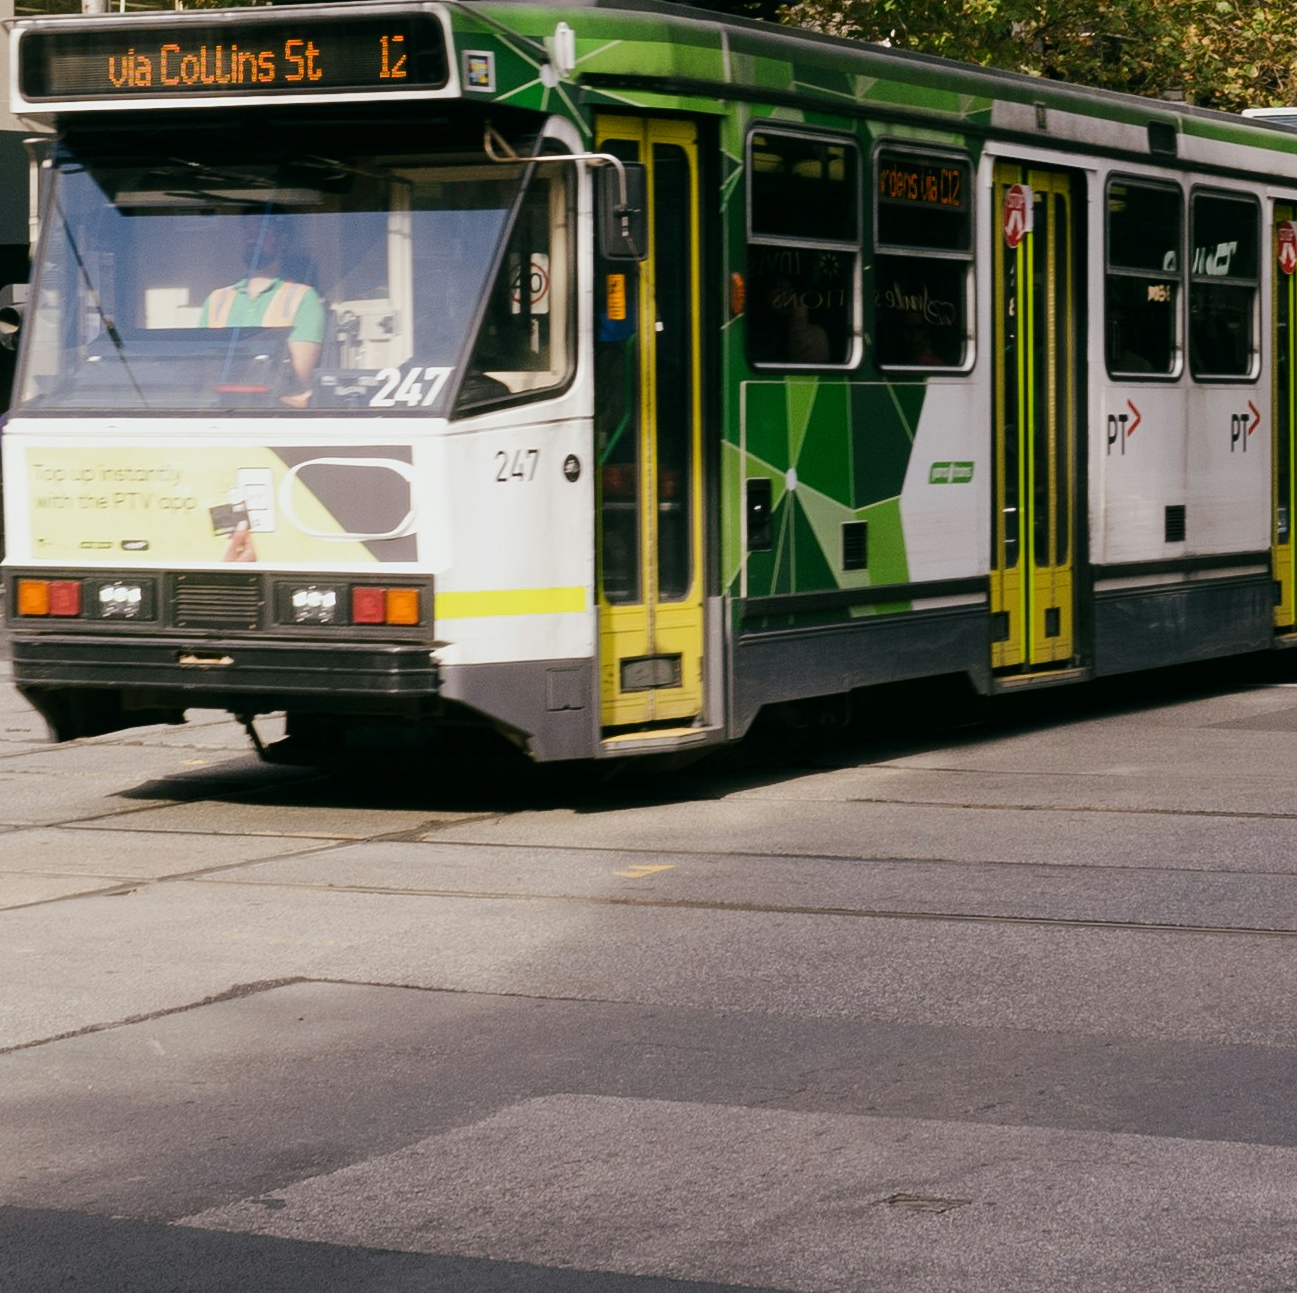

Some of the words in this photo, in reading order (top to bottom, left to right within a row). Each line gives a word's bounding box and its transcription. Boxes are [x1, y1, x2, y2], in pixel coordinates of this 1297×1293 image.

[108, 48, 152, 88] via
[159, 43, 276, 86] Collins
[285, 38, 323, 82] St
[379, 35, 408, 79] 12
[369, 366, 455, 407] 247
[33, 464, 69, 485] Top
[494, 448, 540, 483] 247
